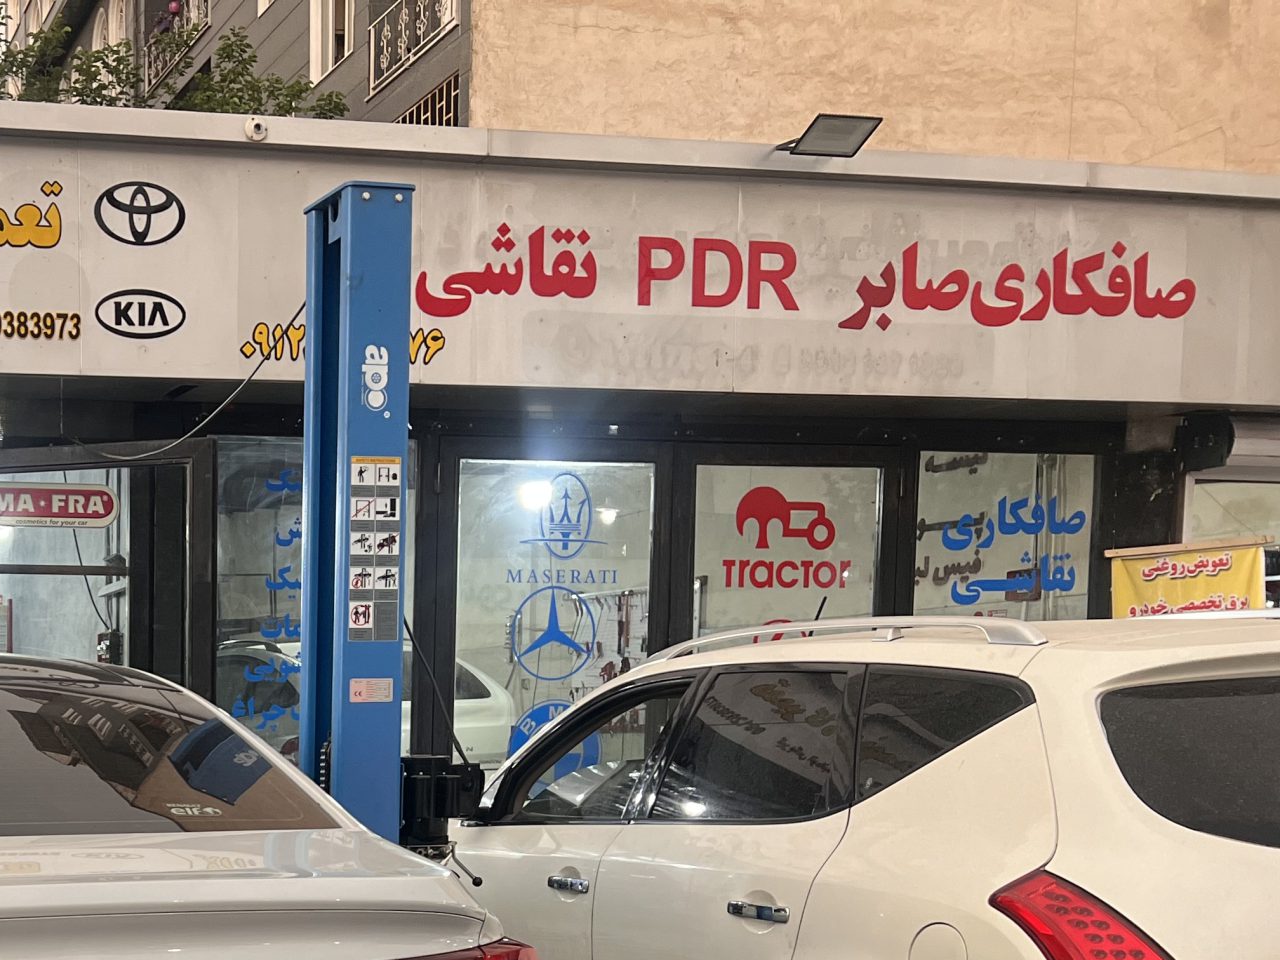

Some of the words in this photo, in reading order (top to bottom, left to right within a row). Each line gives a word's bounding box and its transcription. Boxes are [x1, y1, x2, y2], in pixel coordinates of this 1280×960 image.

[414, 221, 598, 318] نقاشی
[637, 235, 800, 311] PDR
[837, 240, 970, 331] صابر
[970, 240, 1196, 328] صافکاری
[113, 301, 169, 328] KIA
[941, 492, 1087, 551] صافکاری
[504, 568, 619, 584] MASERATI
[950, 550, 1077, 606] نقاشی
